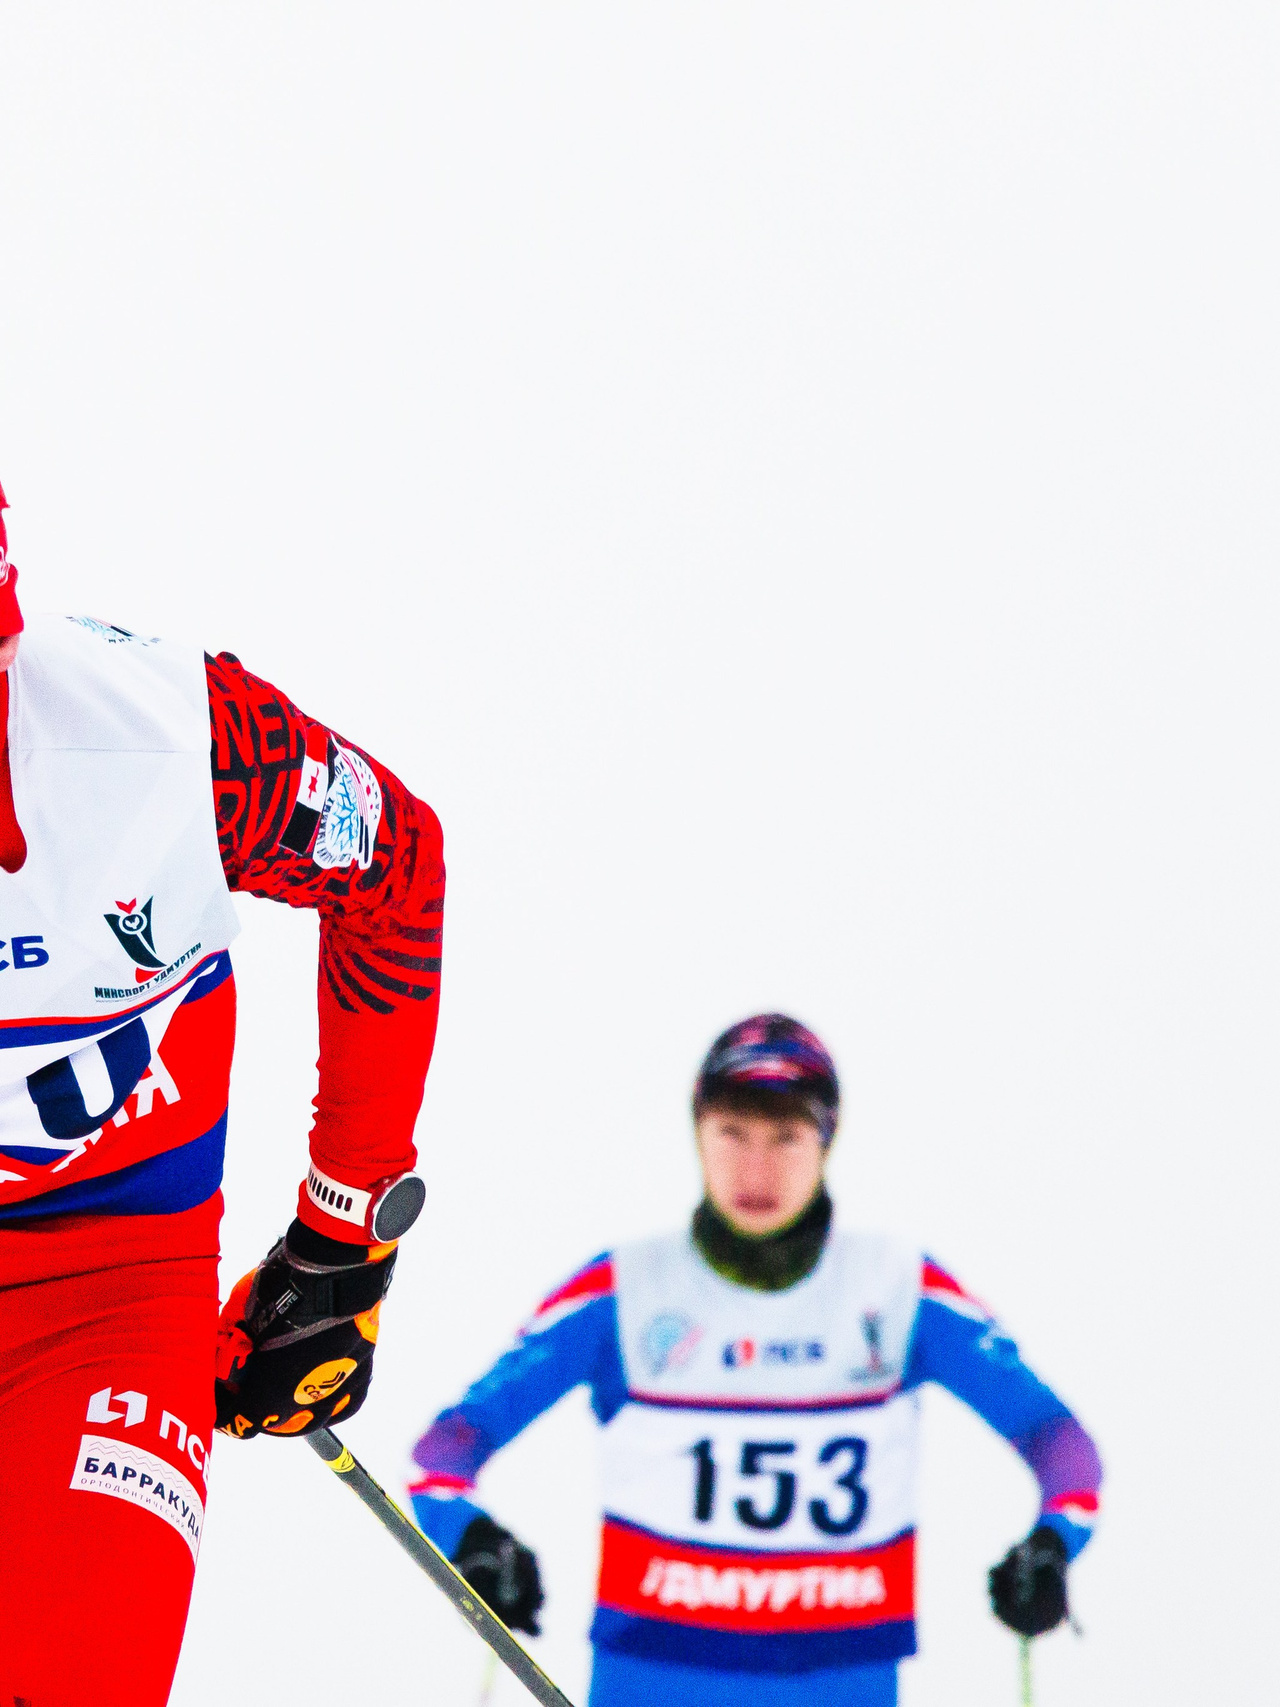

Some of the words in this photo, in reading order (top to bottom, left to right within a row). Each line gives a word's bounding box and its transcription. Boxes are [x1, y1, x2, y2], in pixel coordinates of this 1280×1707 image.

[94, 982, 151, 999] МИНСПОРТ
[153, 941, 202, 983] УДМУРТИИ
[83, 1457, 200, 1540] БАРРАКУДА
[691, 1436, 869, 1536] 153
